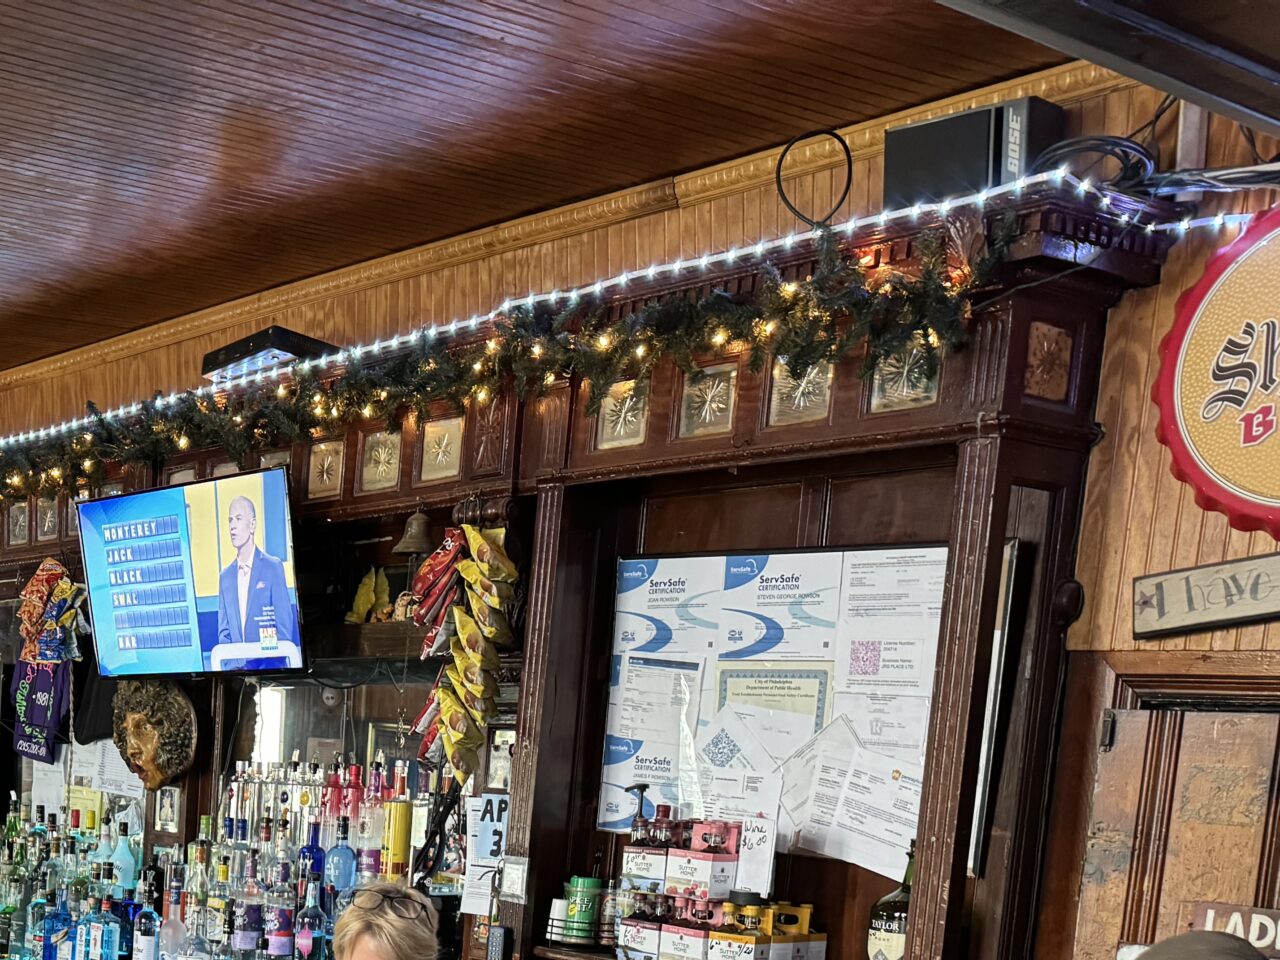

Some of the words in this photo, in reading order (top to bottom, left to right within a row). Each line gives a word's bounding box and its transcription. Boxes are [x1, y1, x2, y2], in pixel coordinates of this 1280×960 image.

[103, 520, 157, 541] MONTEREY
[107, 549, 132, 563] JACK
[109, 568, 142, 584] BLACK
[759, 573, 801, 584] ServSafe
[649, 578, 686, 588] ServSafe
[758, 583, 800, 592] CERTIFICATION
[648, 587, 686, 595] CERTIFICATION
[118, 635, 137, 648] BAR
[635, 755, 671, 766] ServSafe
[634, 764, 671, 773] CERTIFICATION
[744, 820, 766, 834] Wine
[679, 864, 697, 872] SUTTER
[872, 920, 900, 931] TAYLOR
